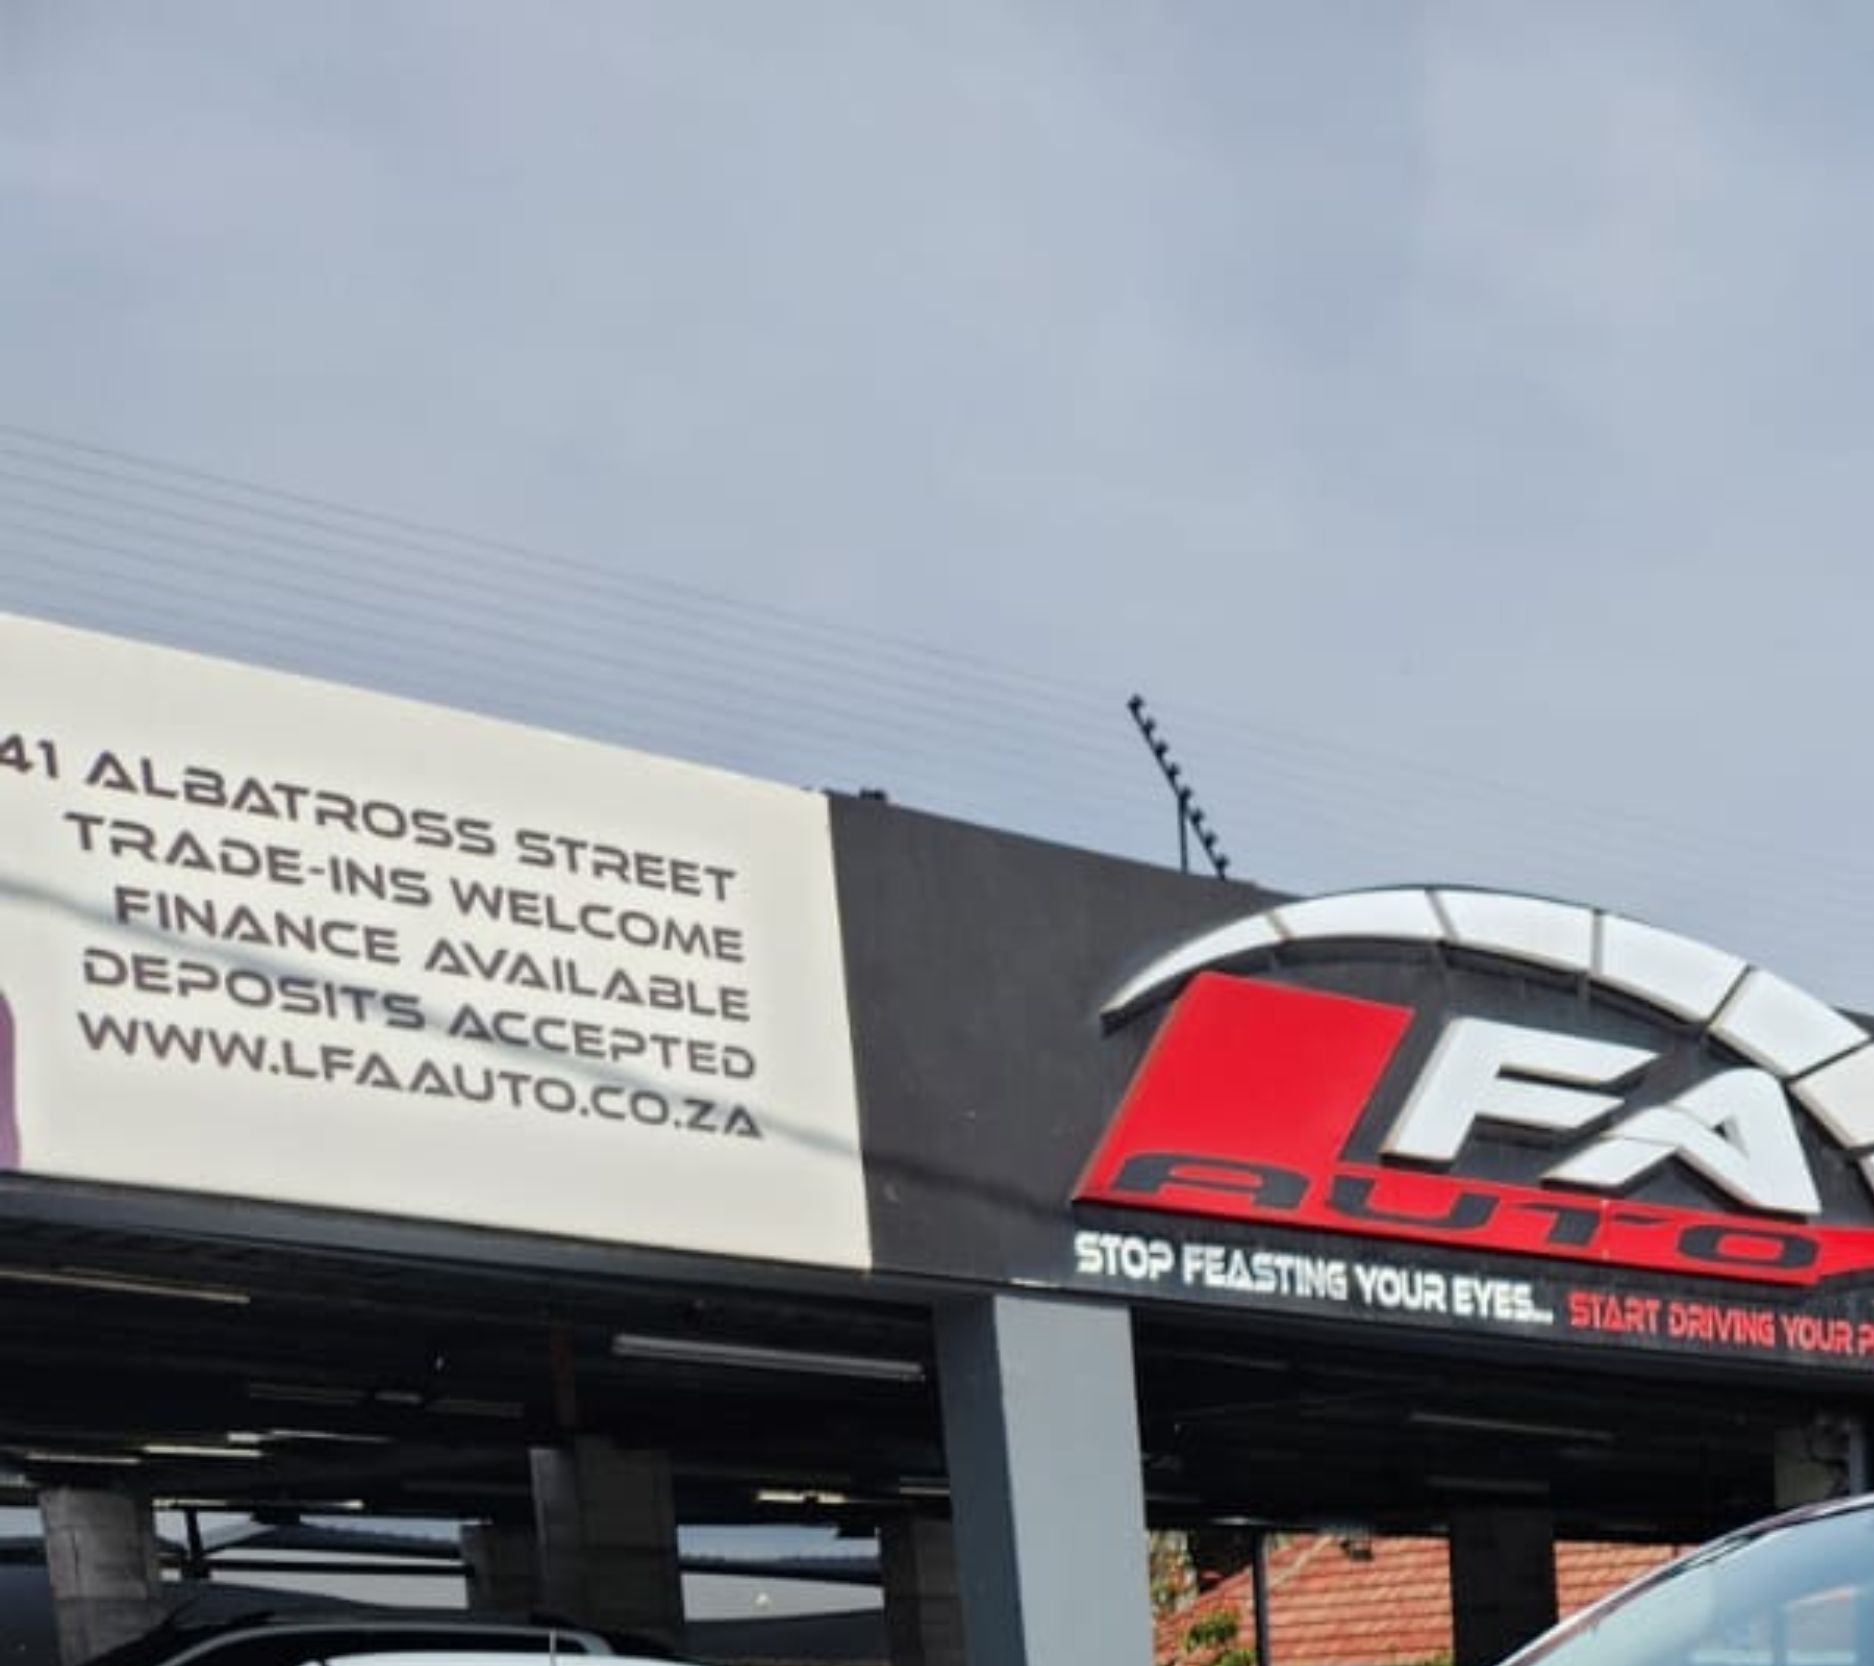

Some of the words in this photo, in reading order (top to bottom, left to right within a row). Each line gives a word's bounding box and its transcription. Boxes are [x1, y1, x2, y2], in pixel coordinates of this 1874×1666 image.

[0, 732, 59, 780] 41
[84, 750, 497, 857] ALBATROSS
[515, 829, 738, 903] STREET
[64, 811, 432, 908] TRADE-INS
[450, 876, 745, 963] WELCOME
[114, 886, 400, 966] FINANCE
[424, 938, 751, 1022] AVAILABLE
[77, 1011, 764, 1140] WWW.LFAAUTO.CO.ZA
[83, 947, 427, 1032] DEPOSITS
[448, 1003, 757, 1081] ACCEPTED
[1110, 1151, 1820, 1272] AUTO
[1074, 1230, 1176, 1283] STOP
[1181, 1241, 1347, 1303] FEASTING
[1353, 1262, 1448, 1312] YOUR
[1568, 1289, 1660, 1334] START
[1667, 1301, 1778, 1354] DRIVING
[1780, 1311, 1855, 1356] YOUR
